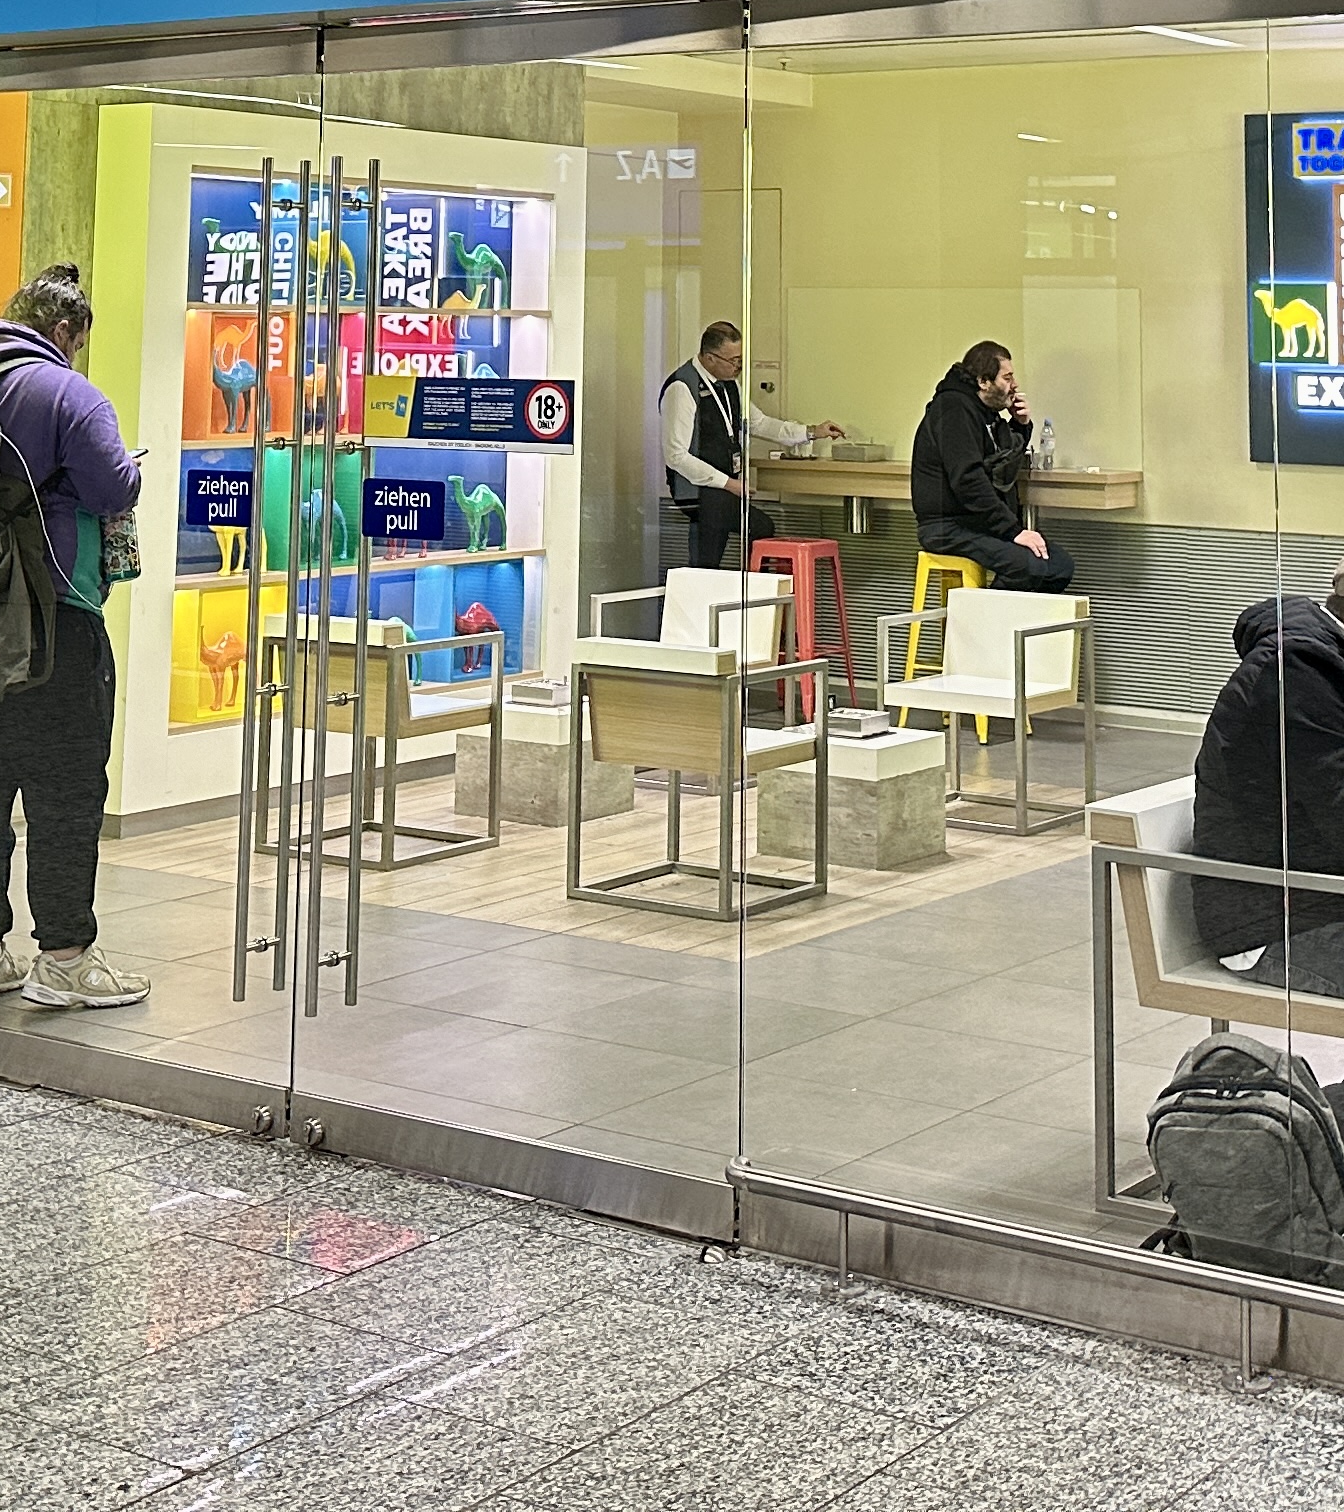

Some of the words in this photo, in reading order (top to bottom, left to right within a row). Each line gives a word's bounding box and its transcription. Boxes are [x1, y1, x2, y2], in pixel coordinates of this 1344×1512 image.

[535, 394, 564, 420] 18+
[197, 474, 249, 496] ziehen
[374, 486, 431, 508] ziehen
[208, 497, 237, 522] pull
[385, 509, 418, 535] pull
